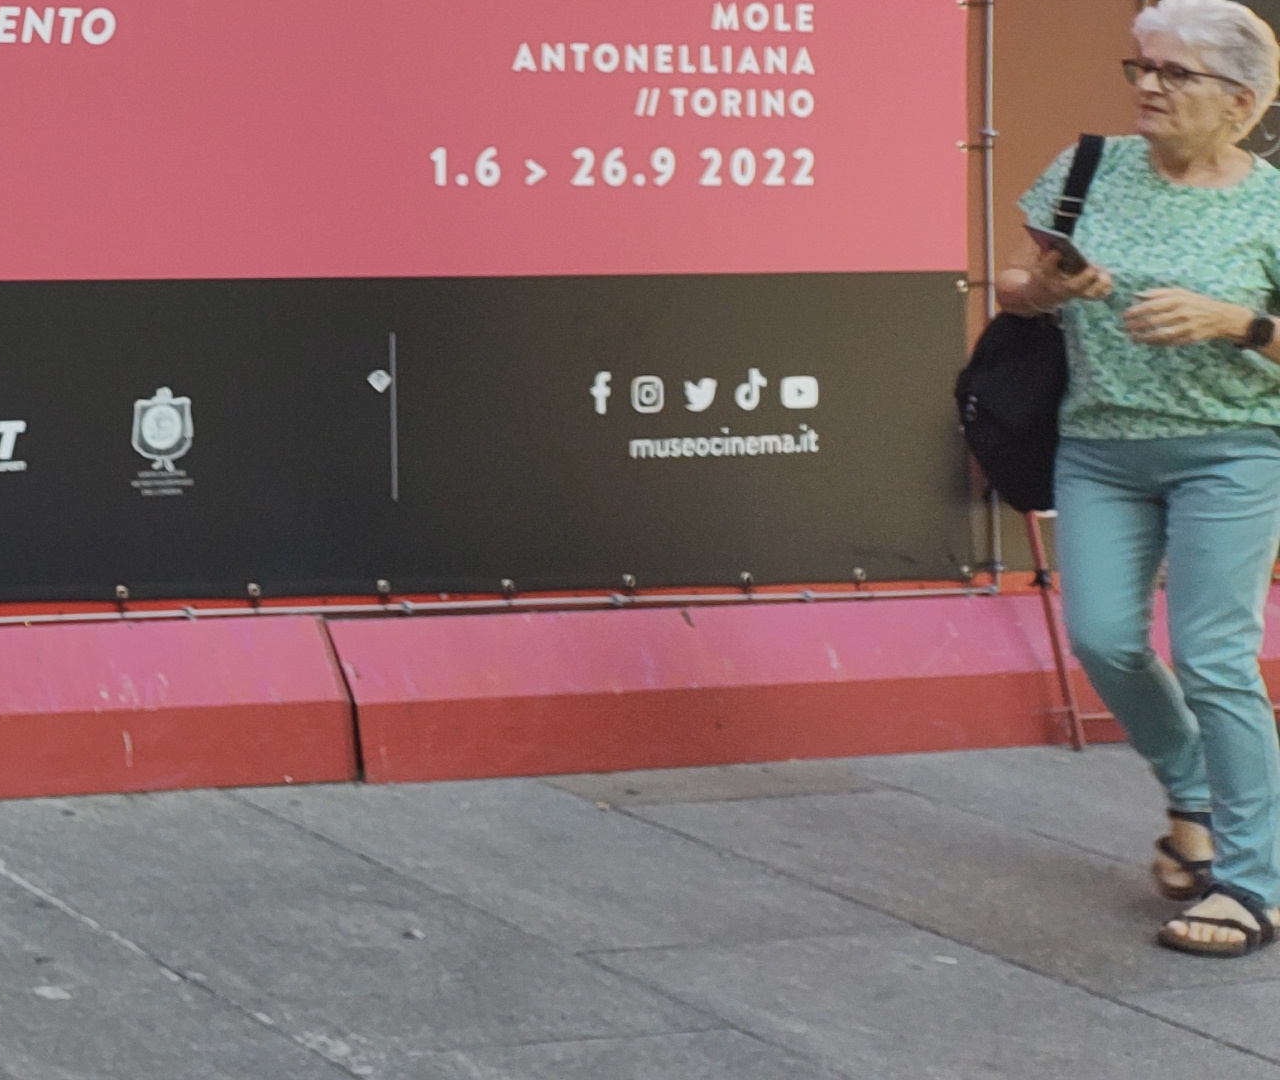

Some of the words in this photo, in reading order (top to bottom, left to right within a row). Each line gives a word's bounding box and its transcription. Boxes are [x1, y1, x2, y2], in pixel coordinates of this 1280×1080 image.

[711, 2, 814, 32] MOLE
[512, 42, 815, 75] ANTONELLIANA
[669, 87, 815, 118] TORINO
[430, 146, 501, 187] 1.6
[572, 147, 676, 187] 26.9
[700, 147, 815, 186] 2022
[629, 423, 820, 459] museocinema.it
